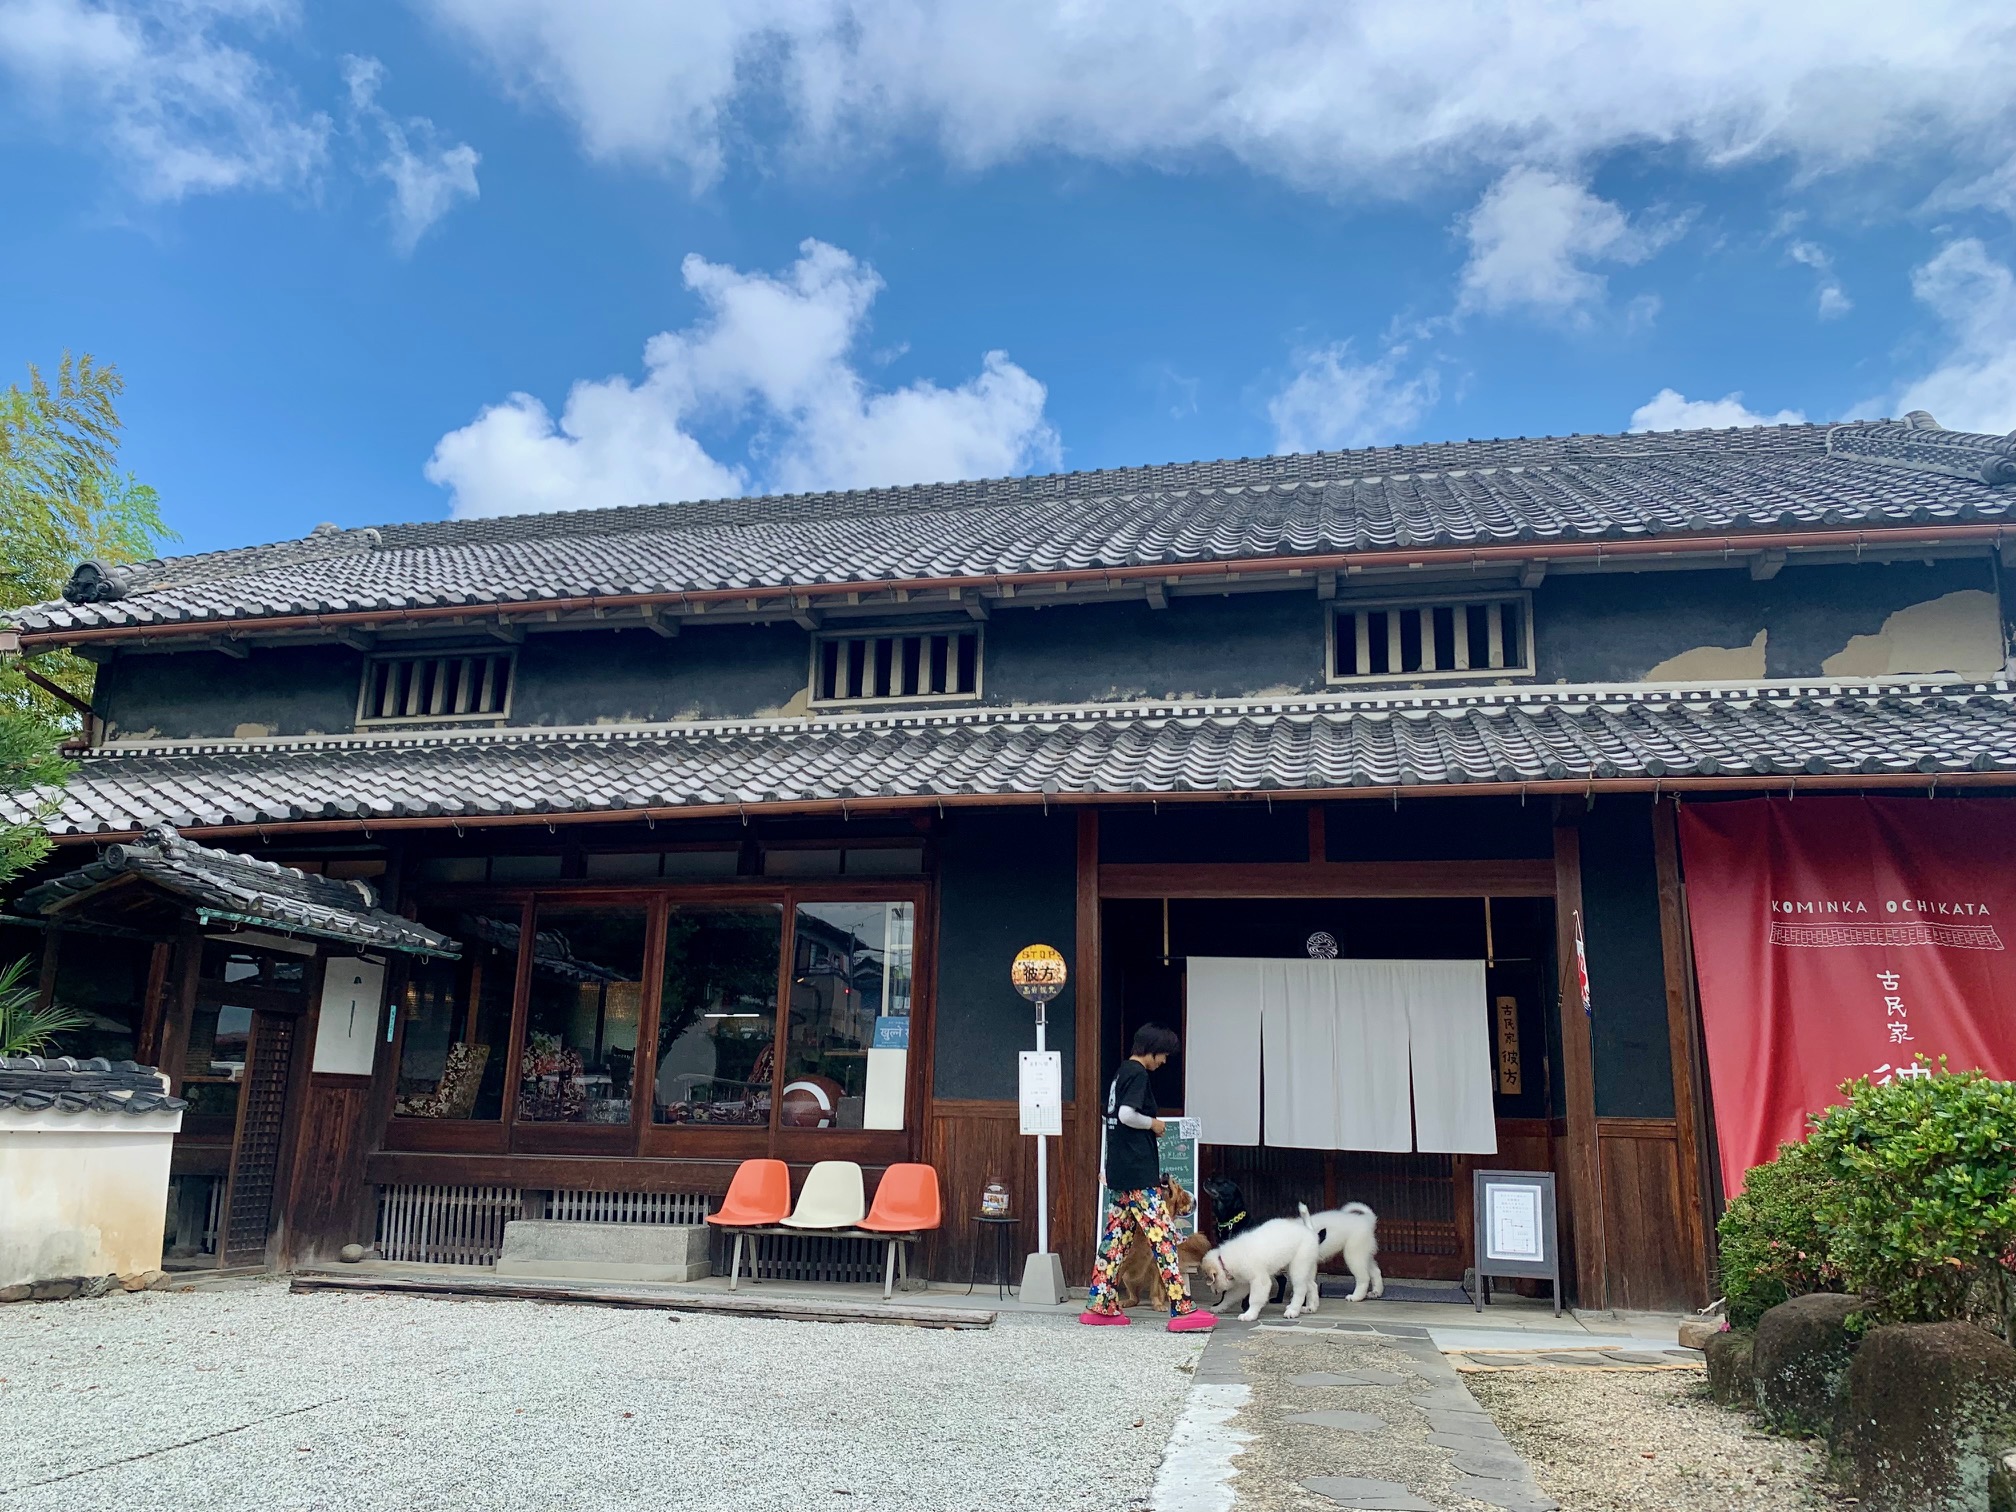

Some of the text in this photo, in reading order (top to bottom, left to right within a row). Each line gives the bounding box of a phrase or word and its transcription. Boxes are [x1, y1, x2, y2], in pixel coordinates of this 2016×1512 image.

[1772, 899, 1990, 916] KOMINKA OCHIKATA
[1022, 950, 1056, 959] STOP
[1023, 963, 1055, 982] 彼方
[1876, 969, 1915, 1044] 古民家
